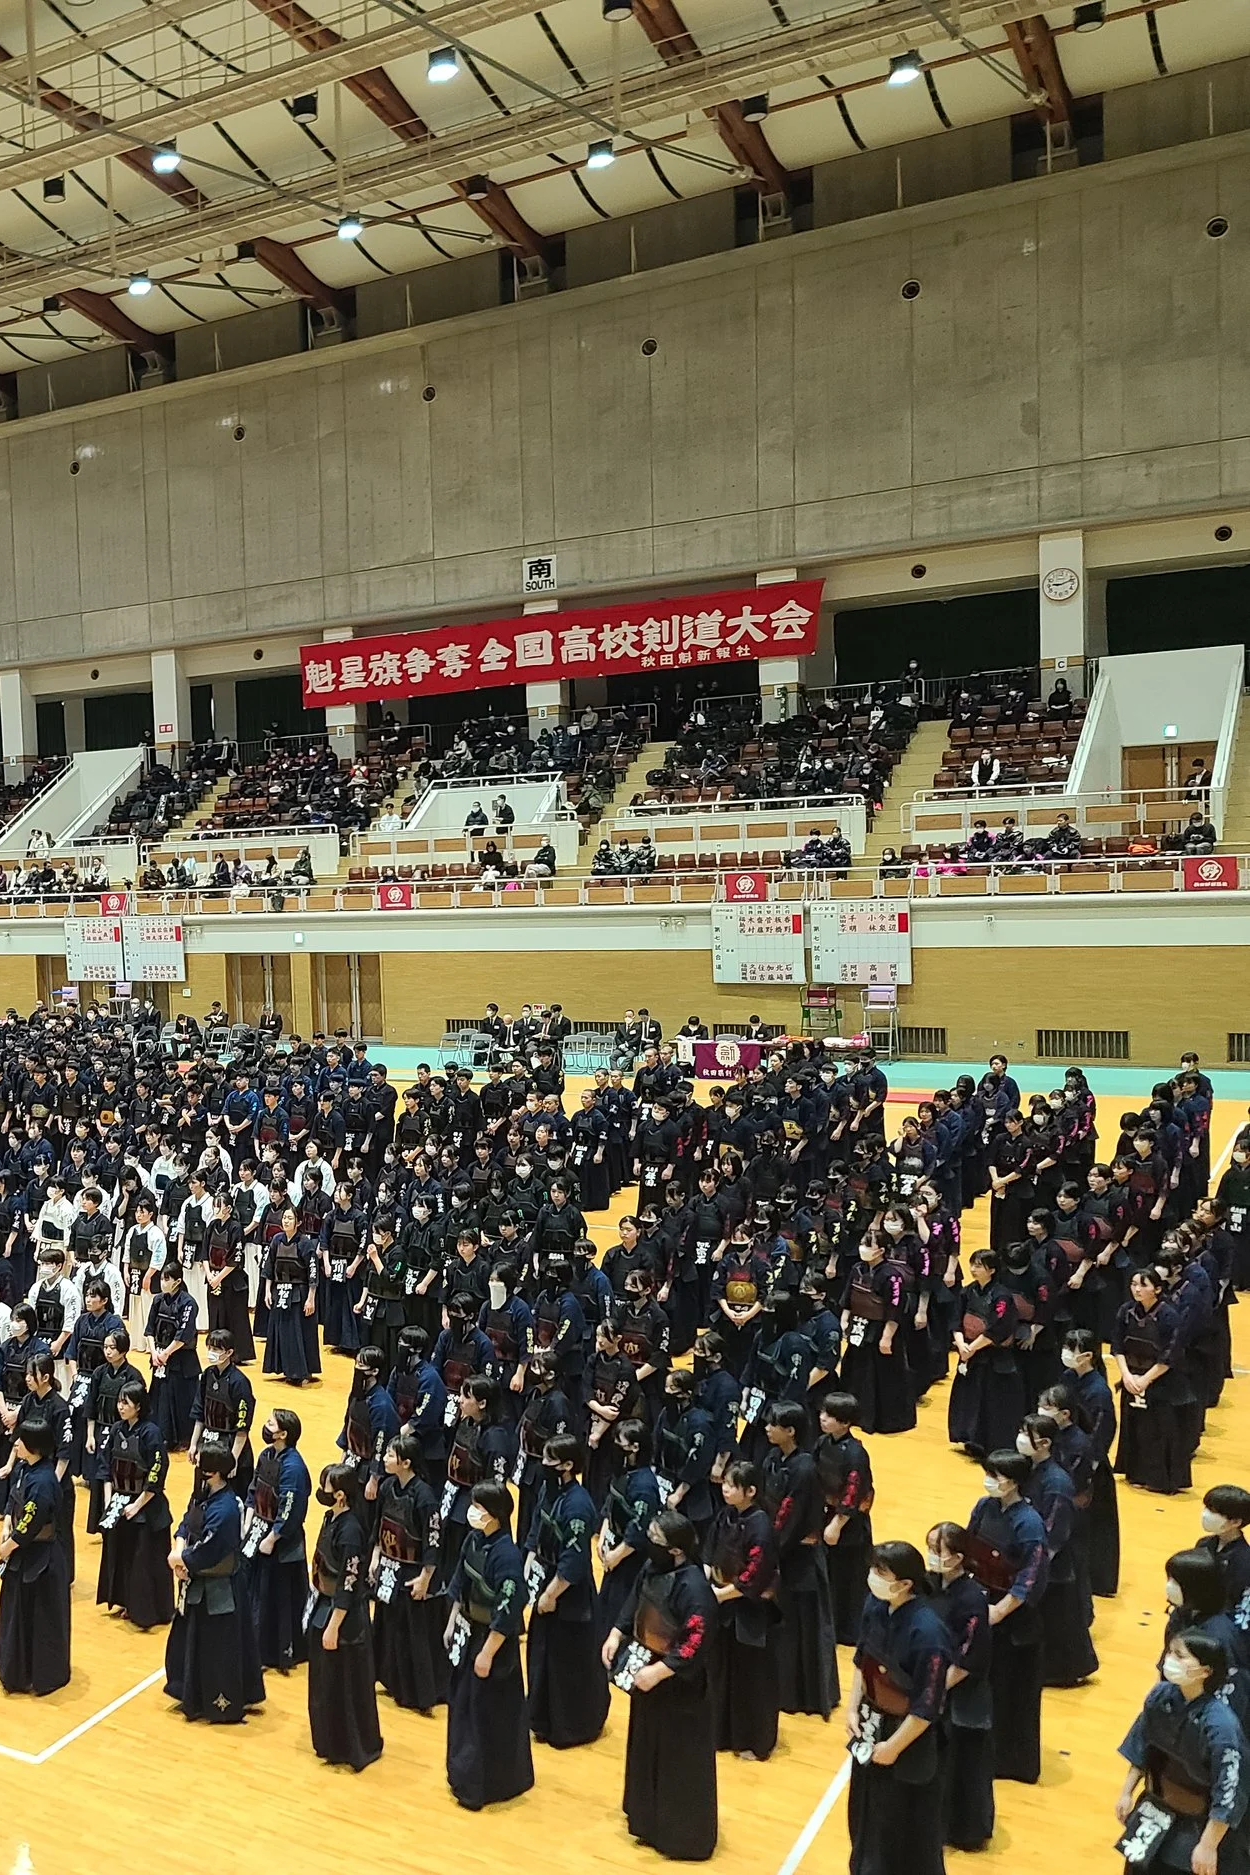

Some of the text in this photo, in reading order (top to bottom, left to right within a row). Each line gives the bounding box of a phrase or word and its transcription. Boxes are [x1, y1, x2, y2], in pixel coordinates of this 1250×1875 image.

[527, 558, 552, 580] 南
[525, 579, 555, 591] SOUTH
[304, 599, 814, 694] 魁星旗争奪全国高校剣道大会
[641, 644, 752, 668] 秋田魁新報社
[1057, 660, 1065, 668] C
[540, 708, 546, 717] B
[339, 728, 343, 736] B
